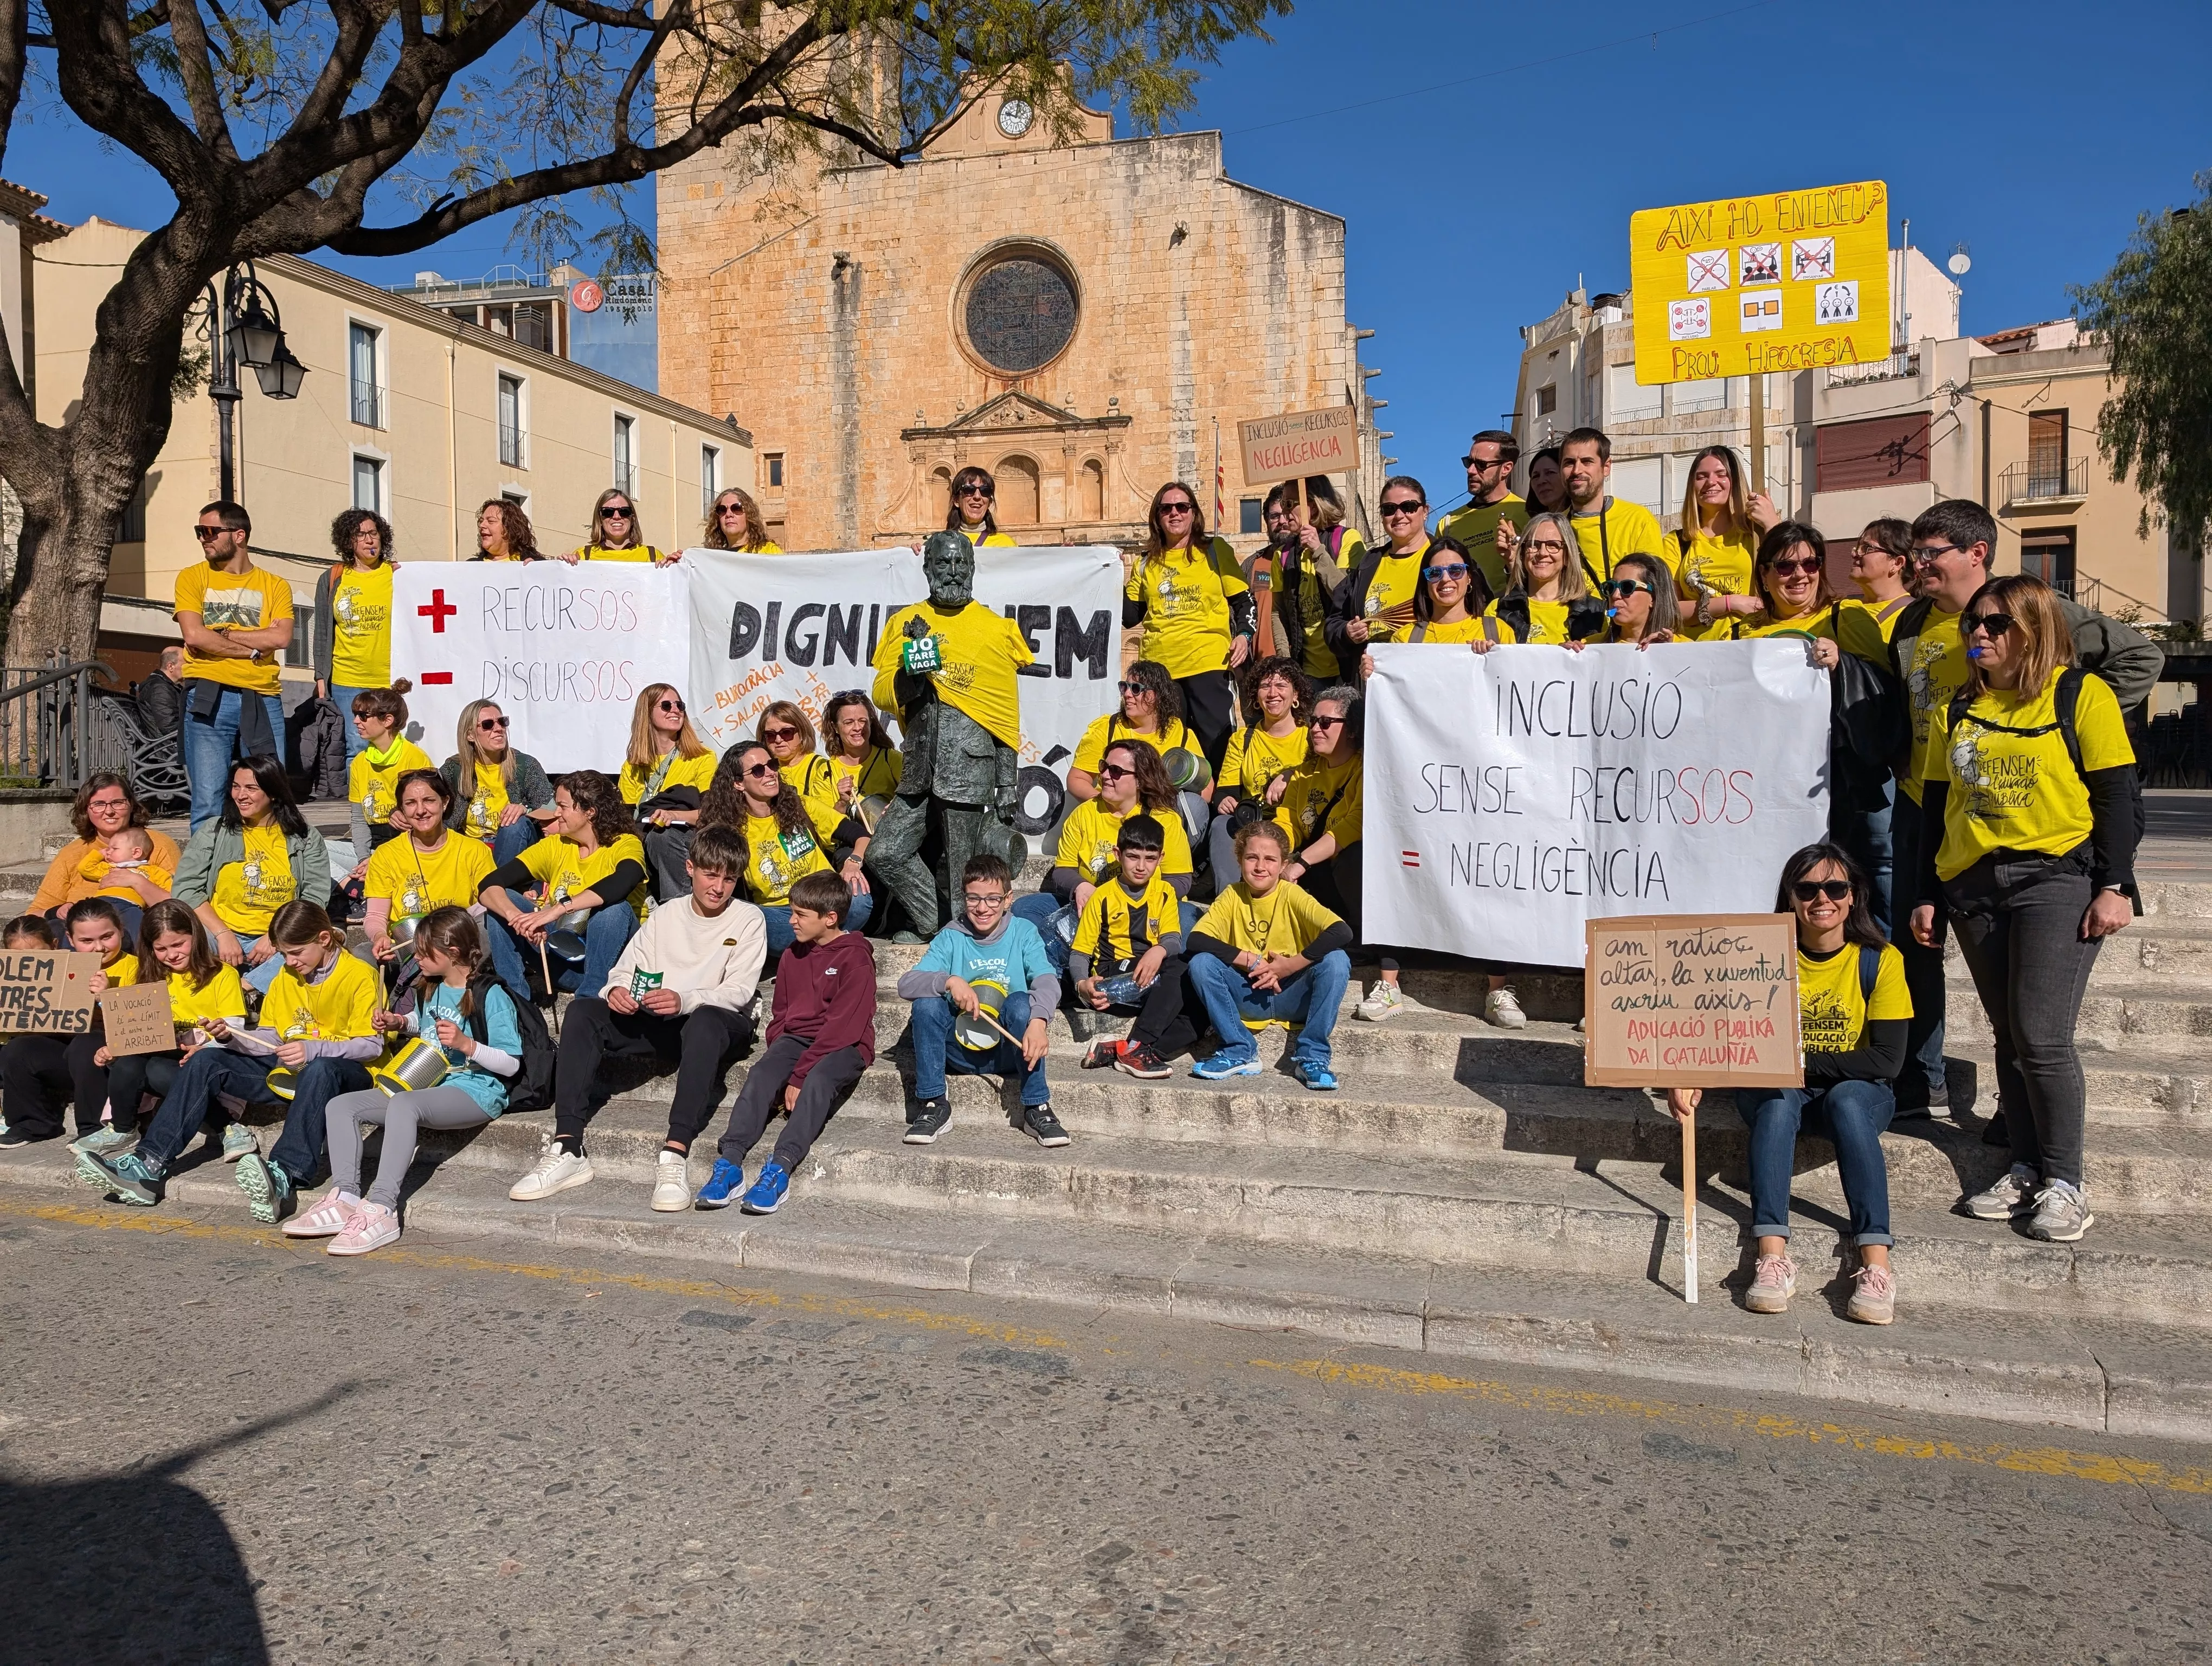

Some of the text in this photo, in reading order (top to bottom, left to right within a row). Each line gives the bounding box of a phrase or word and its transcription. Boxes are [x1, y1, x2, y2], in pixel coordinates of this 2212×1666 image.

[1728, 201, 1763, 239] HO
[605, 280, 653, 297] Casal
[1672, 347, 1719, 380] PROU
[1245, 410, 1349, 443] INCLUSIÓ sense RECURSOS
[483, 585, 638, 632] RECURSOS
[908, 638, 933, 653] JO
[908, 649, 936, 662] FARÉ
[910, 659, 937, 670] VAGA
[1495, 665, 1693, 741] INCLUSIÓ
[1979, 754, 2035, 777] DEFENSEM
[1412, 762, 1755, 826] SENSE RECURSOS
[789, 842, 812, 856] VAGA
[1449, 836, 1670, 902] NEGLIGÈNCIA
[1604, 939, 1649, 958] am
[969, 958, 1007, 970] L'ESCOL
[1670, 960, 1695, 987] la
[1703, 952, 1796, 985] xuventud
[629, 972, 639, 998] VAGA
[108, 993, 152, 1011] LA VOCACIÓ
[0, 1008, 90, 1033] TENTES
[117, 1014, 124, 1024] té
[120, 1027, 126, 1035] el
[129, 1026, 143, 1034] nostre
[1628, 1046, 1650, 1066] DA
